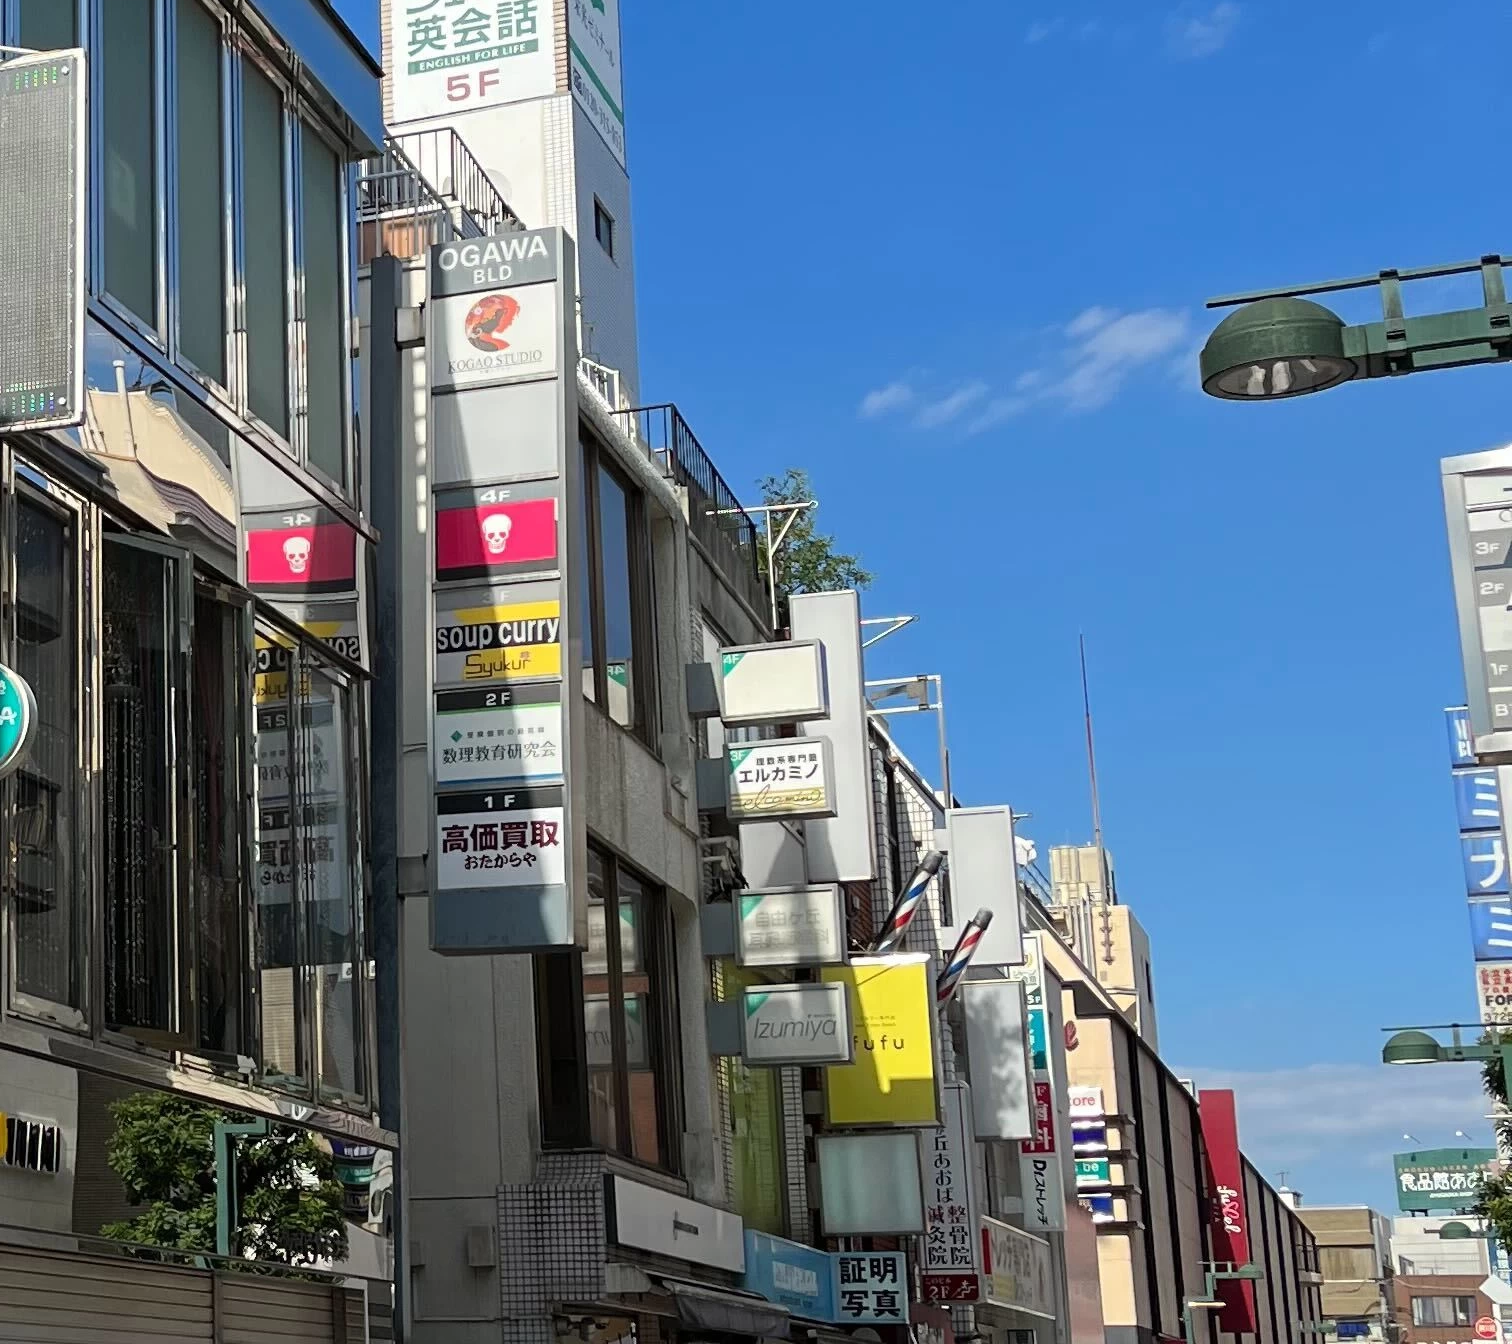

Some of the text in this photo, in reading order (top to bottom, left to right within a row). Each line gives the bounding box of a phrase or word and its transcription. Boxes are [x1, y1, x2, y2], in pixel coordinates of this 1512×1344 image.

[419, 42, 526, 71] ENGLISH FOR LIFE
[446, 68, 500, 102] 5F
[439, 235, 548, 271] OGAWA
[473, 265, 512, 284] BLD
[496, 350, 542, 367] STUDIO
[480, 489, 512, 503] 4F
[1475, 541, 1500, 556] 3F
[1480, 581, 1505, 596] 2F
[437, 617, 560, 650] soup curry
[465, 649, 532, 679] Syukur
[485, 692, 512, 706] 2F
[1494, 703, 1512, 717] B
[442, 740, 556, 764] 数理教育研究会
[755, 753, 818, 766] 理数系専門塾
[739, 763, 819, 784] エルカミノ
[484, 795, 516, 808] 1F
[441, 820, 560, 854] 高価買取
[464, 852, 537, 870] おたからや
[753, 1017, 837, 1042] Izumiya
[947, 1205, 972, 1265] 整骨院
[839, 1256, 898, 1285] 証明
[841, 1290, 901, 1318] 写真
[929, 1286, 949, 1301] 2F
